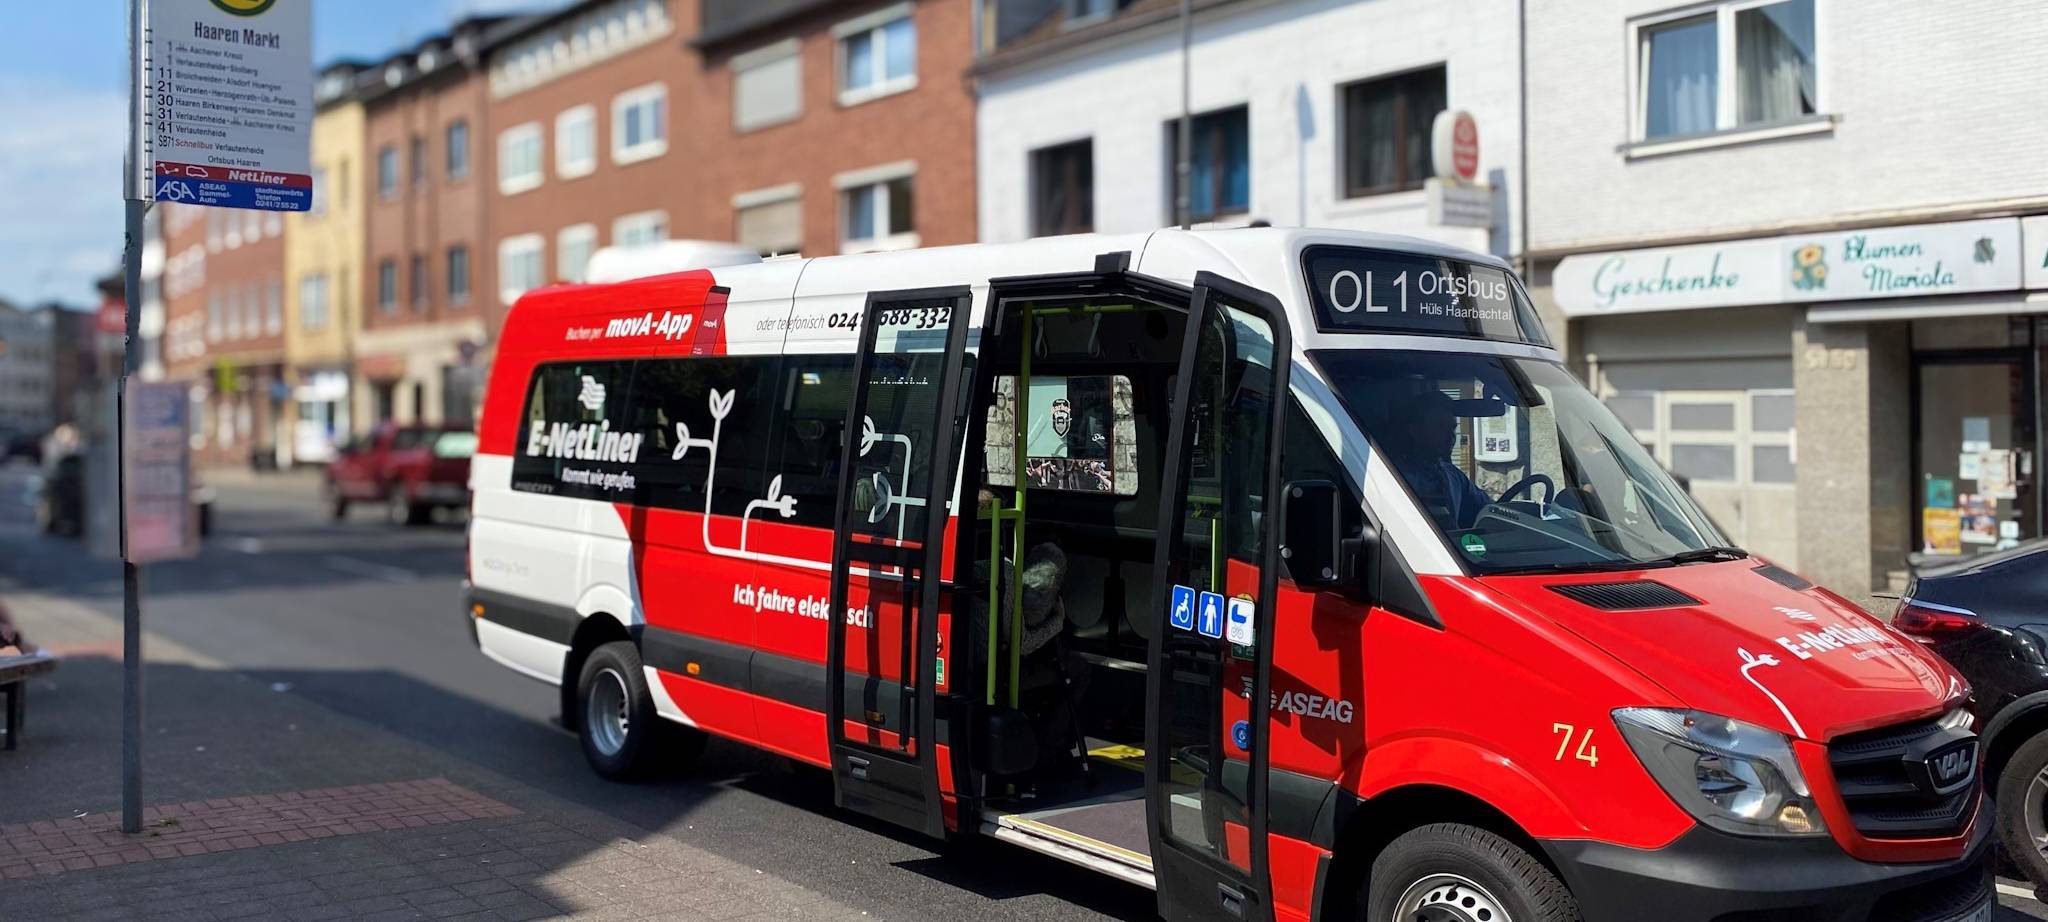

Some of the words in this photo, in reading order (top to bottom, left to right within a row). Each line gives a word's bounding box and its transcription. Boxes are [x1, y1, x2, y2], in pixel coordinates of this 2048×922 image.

[194, 21, 239, 44] Haaren
[243, 28, 281, 49] Markt
[167, 41, 173, 52] 1
[167, 56, 172, 66] 1
[159, 67, 173, 79] 11
[157, 81, 172, 93] 21
[157, 95, 173, 106] 30
[175, 98, 200, 108] Haaren
[202, 101, 238, 113] Birkenweg
[158, 108, 172, 120] 31
[176, 112, 226, 124] Verlautenheide
[158, 121, 172, 133] 41
[176, 125, 226, 137] Verlautenheide
[158, 135, 175, 148] SB71
[175, 139, 213, 150] Schnellbus
[215, 143, 265, 155] Verlautenheide
[208, 155, 235, 166] Ortsbus
[236, 158, 261, 167] Haaren
[199, 182, 227, 191] ASEAG
[228, 169, 287, 185] NetLiner
[156, 181, 196, 201] ASA
[199, 189, 232, 198] Sammel-
[199, 196, 217, 204] Auto
[255, 193, 281, 202] Telefon
[1843, 235, 1924, 263] Blumen
[1592, 252, 1739, 307] Geschenke
[1861, 261, 1955, 291] Mariola
[1418, 270, 1507, 302] Ortsbus
[1419, 302, 1443, 316] Hüls
[1445, 304, 1513, 322] Haarbachtal
[604, 311, 694, 340] movA-App
[756, 315, 776, 331] oder
[776, 313, 826, 331] telefonisch
[526, 419, 644, 463] E-NetLiner
[561, 467, 591, 484] Kommt
[589, 469, 605, 486] wie
[603, 471, 636, 491] gerufen.
[733, 583, 755, 607] Ich
[755, 586, 795, 613] fahre
[797, 595, 874, 628] eleksch
[1278, 691, 1353, 723] ASEAG
[1552, 722, 1599, 768] 74
